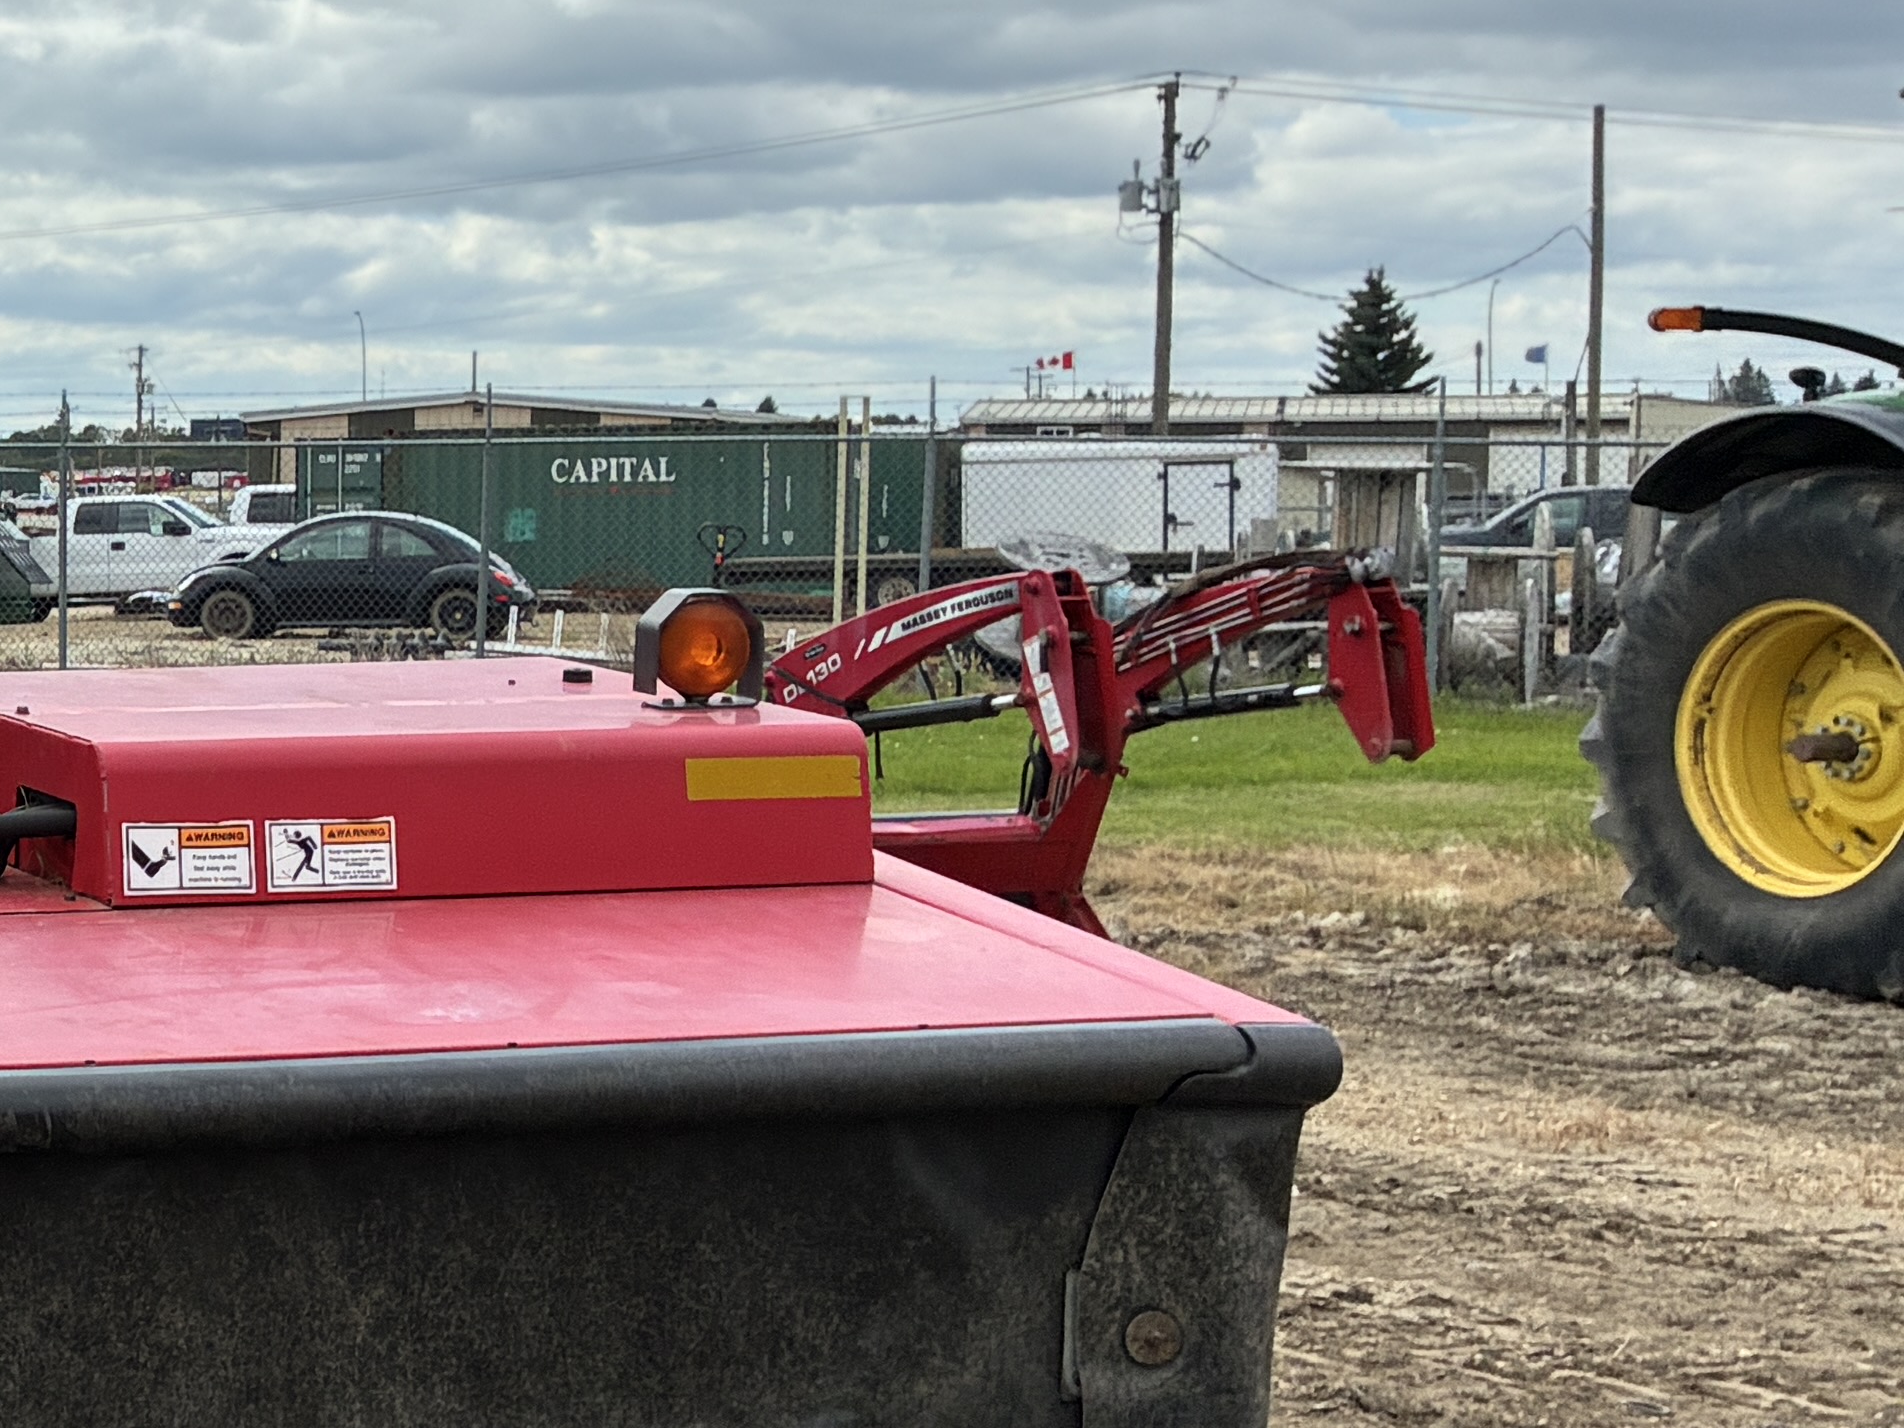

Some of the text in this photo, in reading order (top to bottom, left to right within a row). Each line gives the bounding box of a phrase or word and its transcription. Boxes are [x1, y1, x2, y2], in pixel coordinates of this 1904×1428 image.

[550, 456, 676, 483] CAPITAL
[900, 588, 1014, 632] MASSEY FERGUSON
[806, 652, 842, 686] 130
[194, 831, 244, 842] WARNING
[336, 827, 386, 838] WARNING
